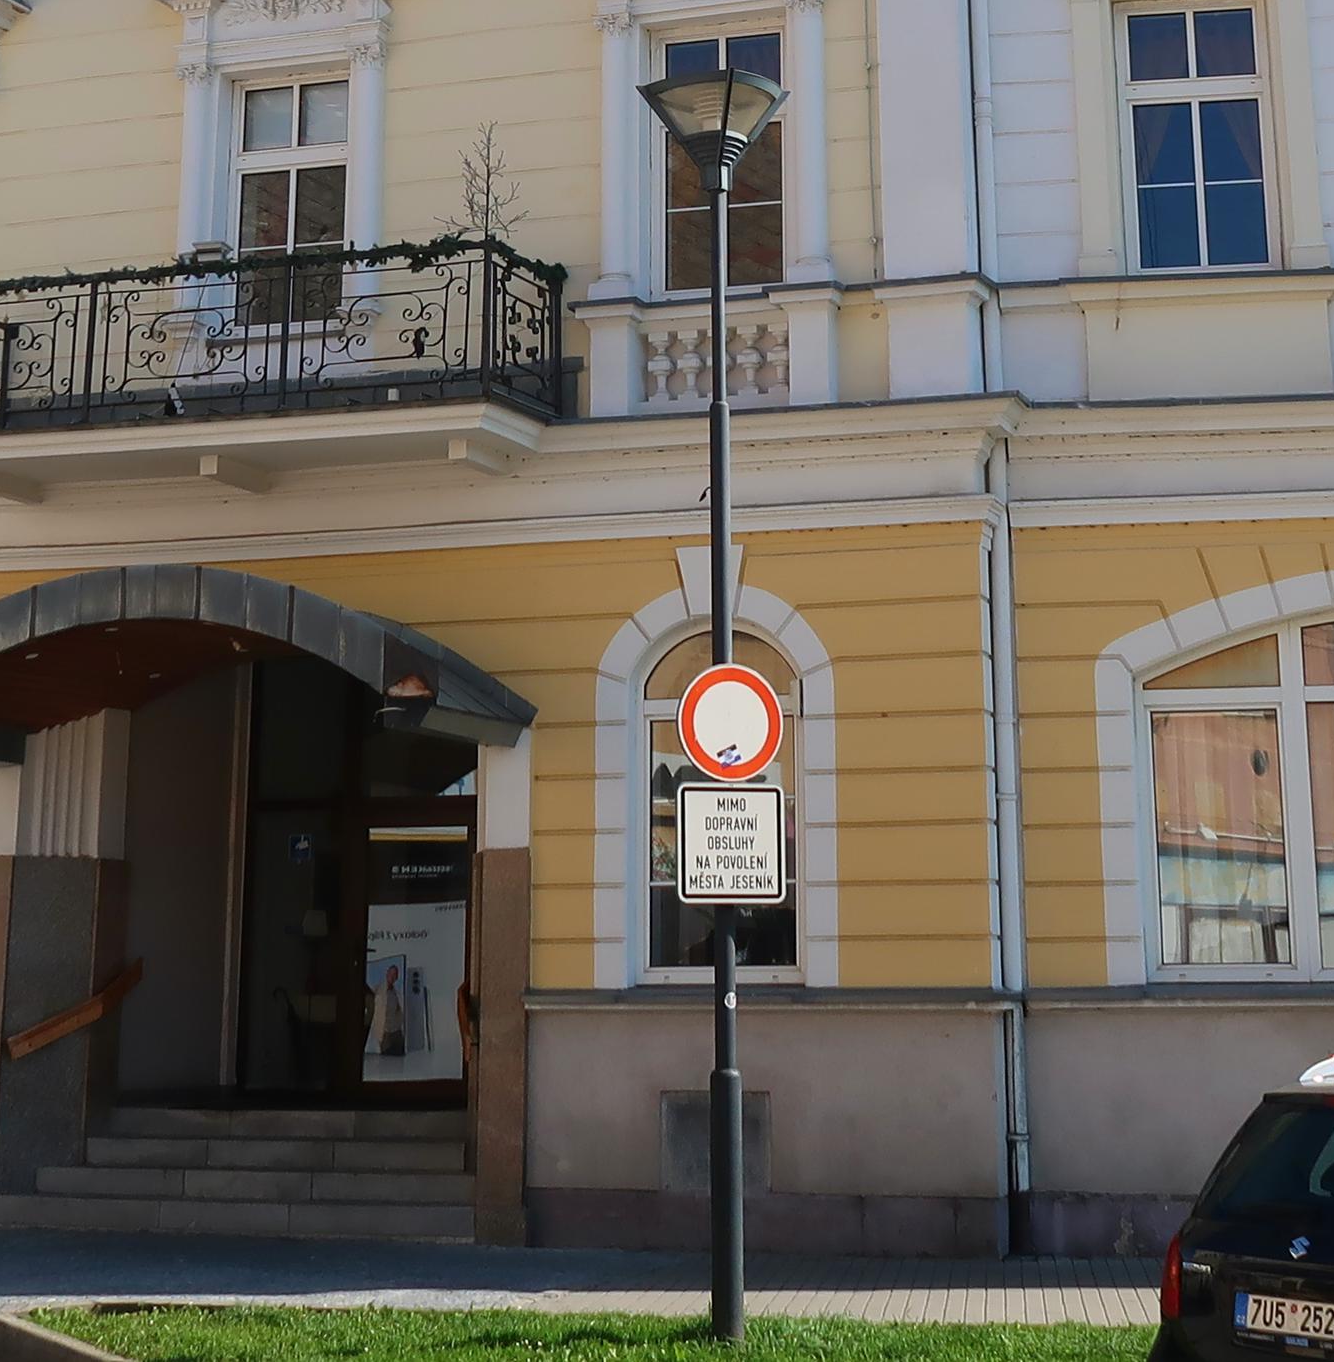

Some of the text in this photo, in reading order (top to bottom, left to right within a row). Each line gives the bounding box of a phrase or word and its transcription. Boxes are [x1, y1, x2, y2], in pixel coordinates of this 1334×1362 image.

[717, 798, 747, 812] MIMO
[705, 814, 758, 831] DOPRAVNÍ
[707, 836, 755, 850] OBSLUHY
[696, 852, 768, 869] NA POVOLENÍ
[689, 870, 774, 889] MĚSTA JESENÍK
[1250, 1297, 1285, 1329] 7U5
